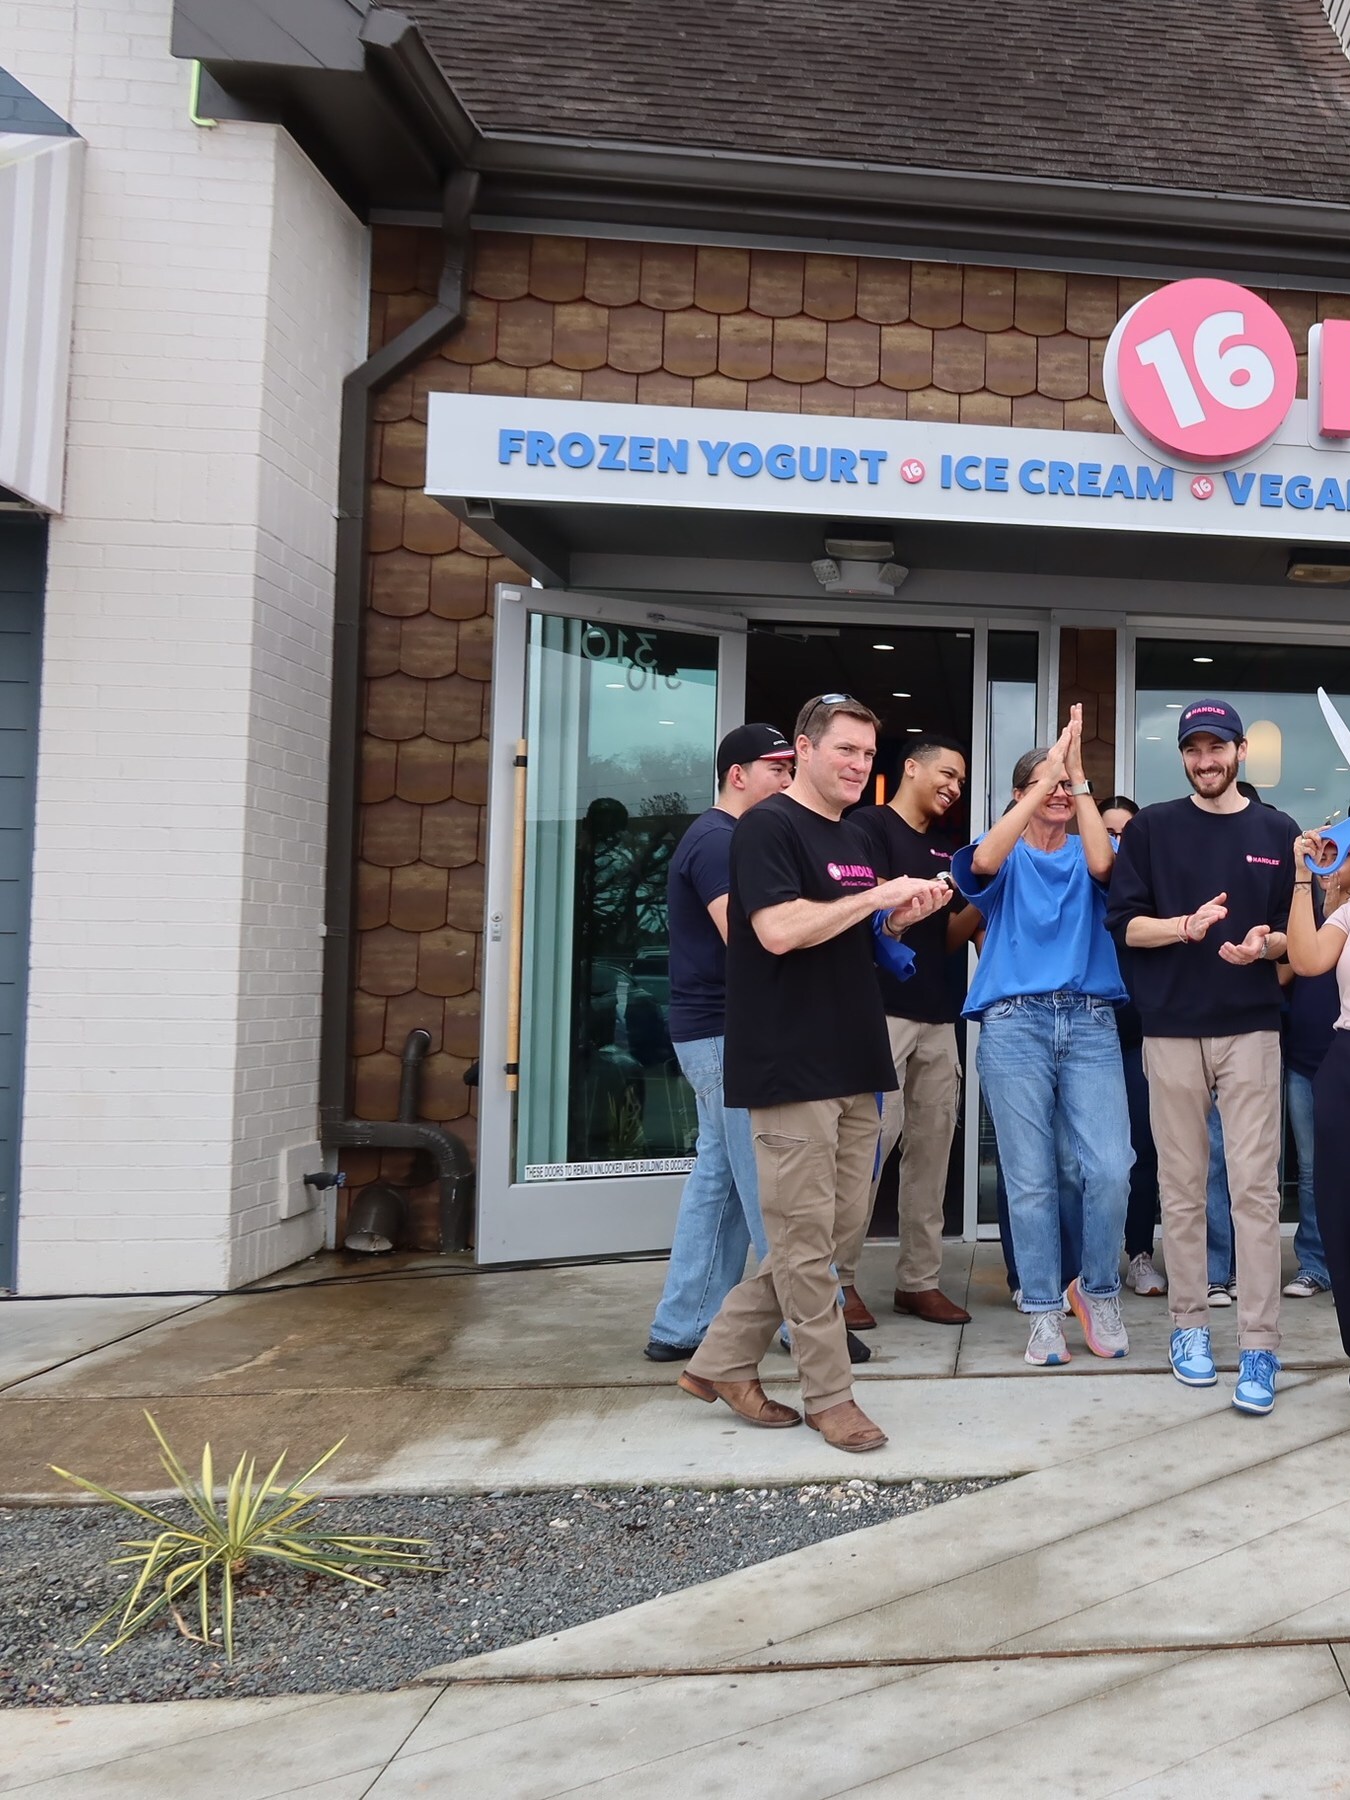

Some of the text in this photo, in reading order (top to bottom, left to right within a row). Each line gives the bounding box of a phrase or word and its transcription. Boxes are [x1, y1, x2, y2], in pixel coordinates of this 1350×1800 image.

[1135, 311, 1276, 429] 16
[498, 429, 689, 475] FROZEN
[699, 440, 888, 486] YOGURT
[901, 461, 923, 480] 16
[941, 455, 1009, 493] ICE
[1019, 459, 1175, 502] CREAM
[1192, 478, 1212, 496] 16
[1192, 706, 1226, 716] HANDLES
[1252, 856, 1280, 866] HANDLES
[838, 864, 875, 879] HANDLE
[525, 1166, 544, 1178] THESE
[545, 1165, 564, 1177] DOORS
[565, 1164, 572, 1176] TO
[573, 1163, 594, 1175] REMAIN
[594, 1162, 623, 1175] UNLOCKED
[624, 1161, 639, 1173] WHEN
[640, 1160, 664, 1172] BUILDING
